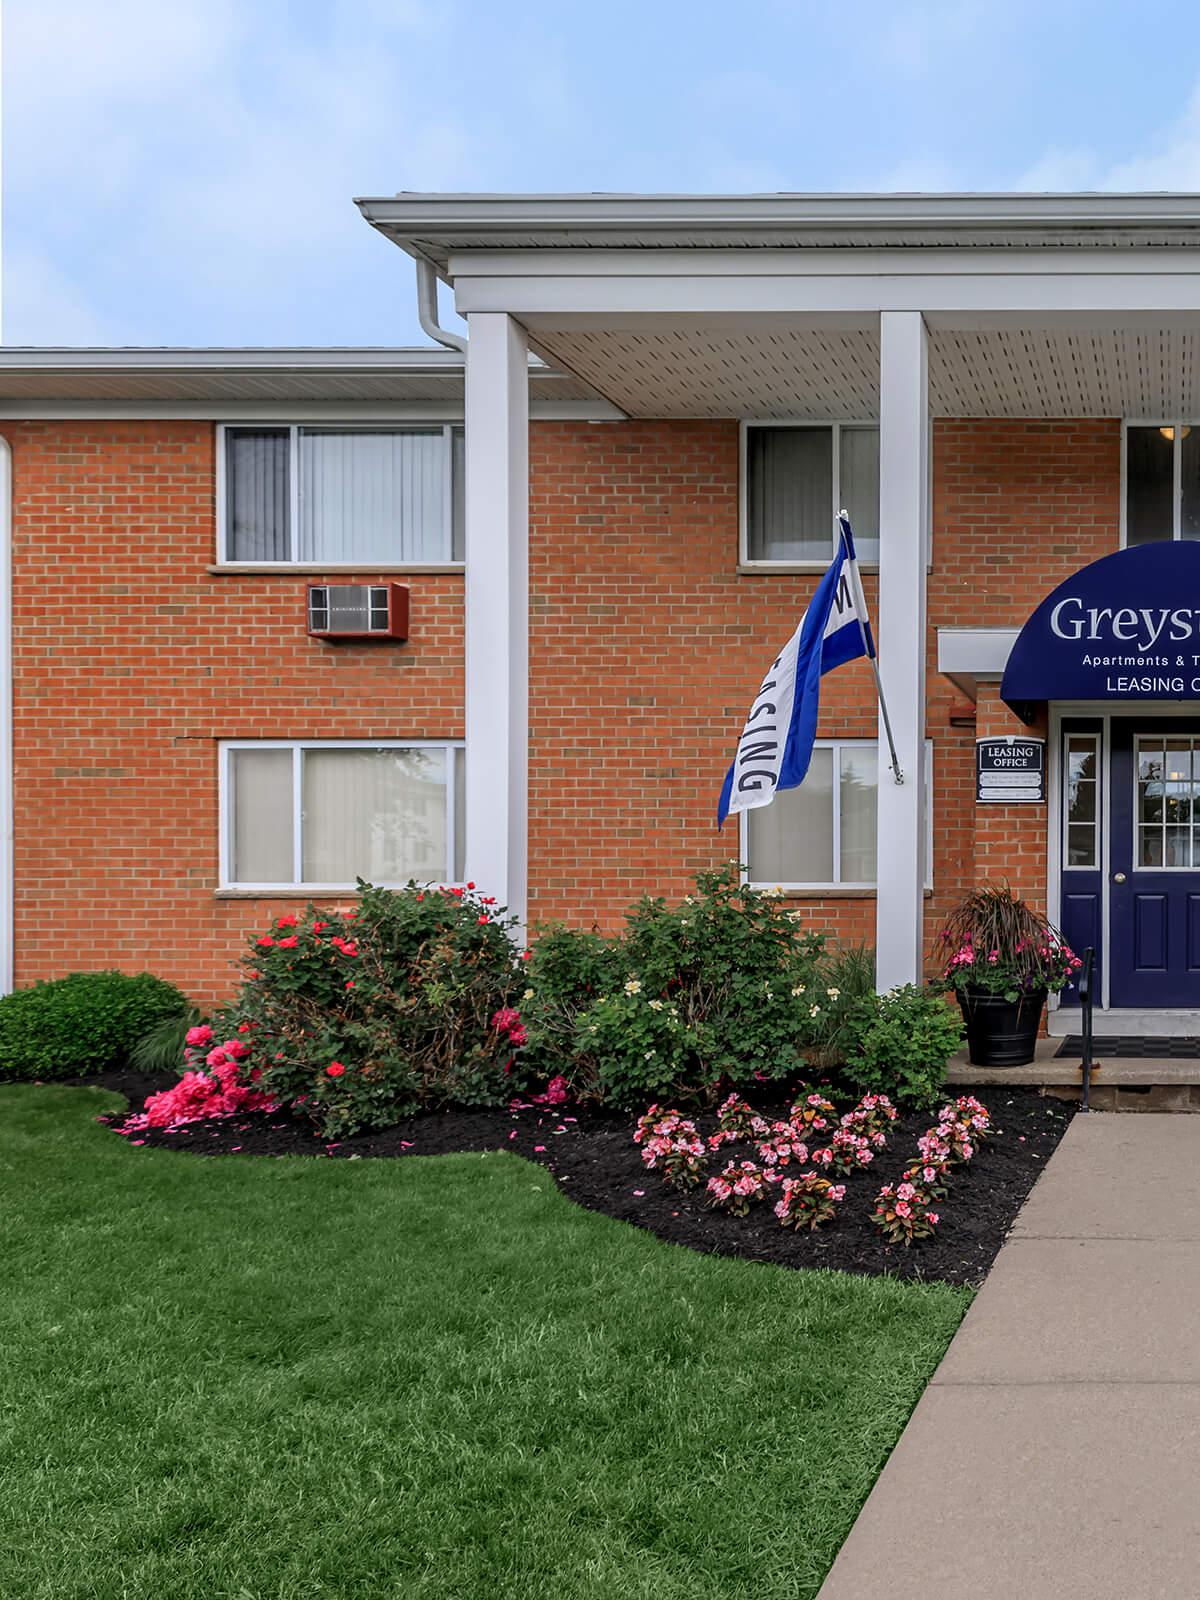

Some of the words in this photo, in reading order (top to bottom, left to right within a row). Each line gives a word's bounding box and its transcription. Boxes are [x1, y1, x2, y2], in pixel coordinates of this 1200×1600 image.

[1082, 654, 1169, 668] Apartments
[1175, 655, 1185, 667] &
[1106, 676, 1185, 692] LEASING
[988, 747, 1034, 757] LEASING
[993, 758, 1028, 767] OFFICE
